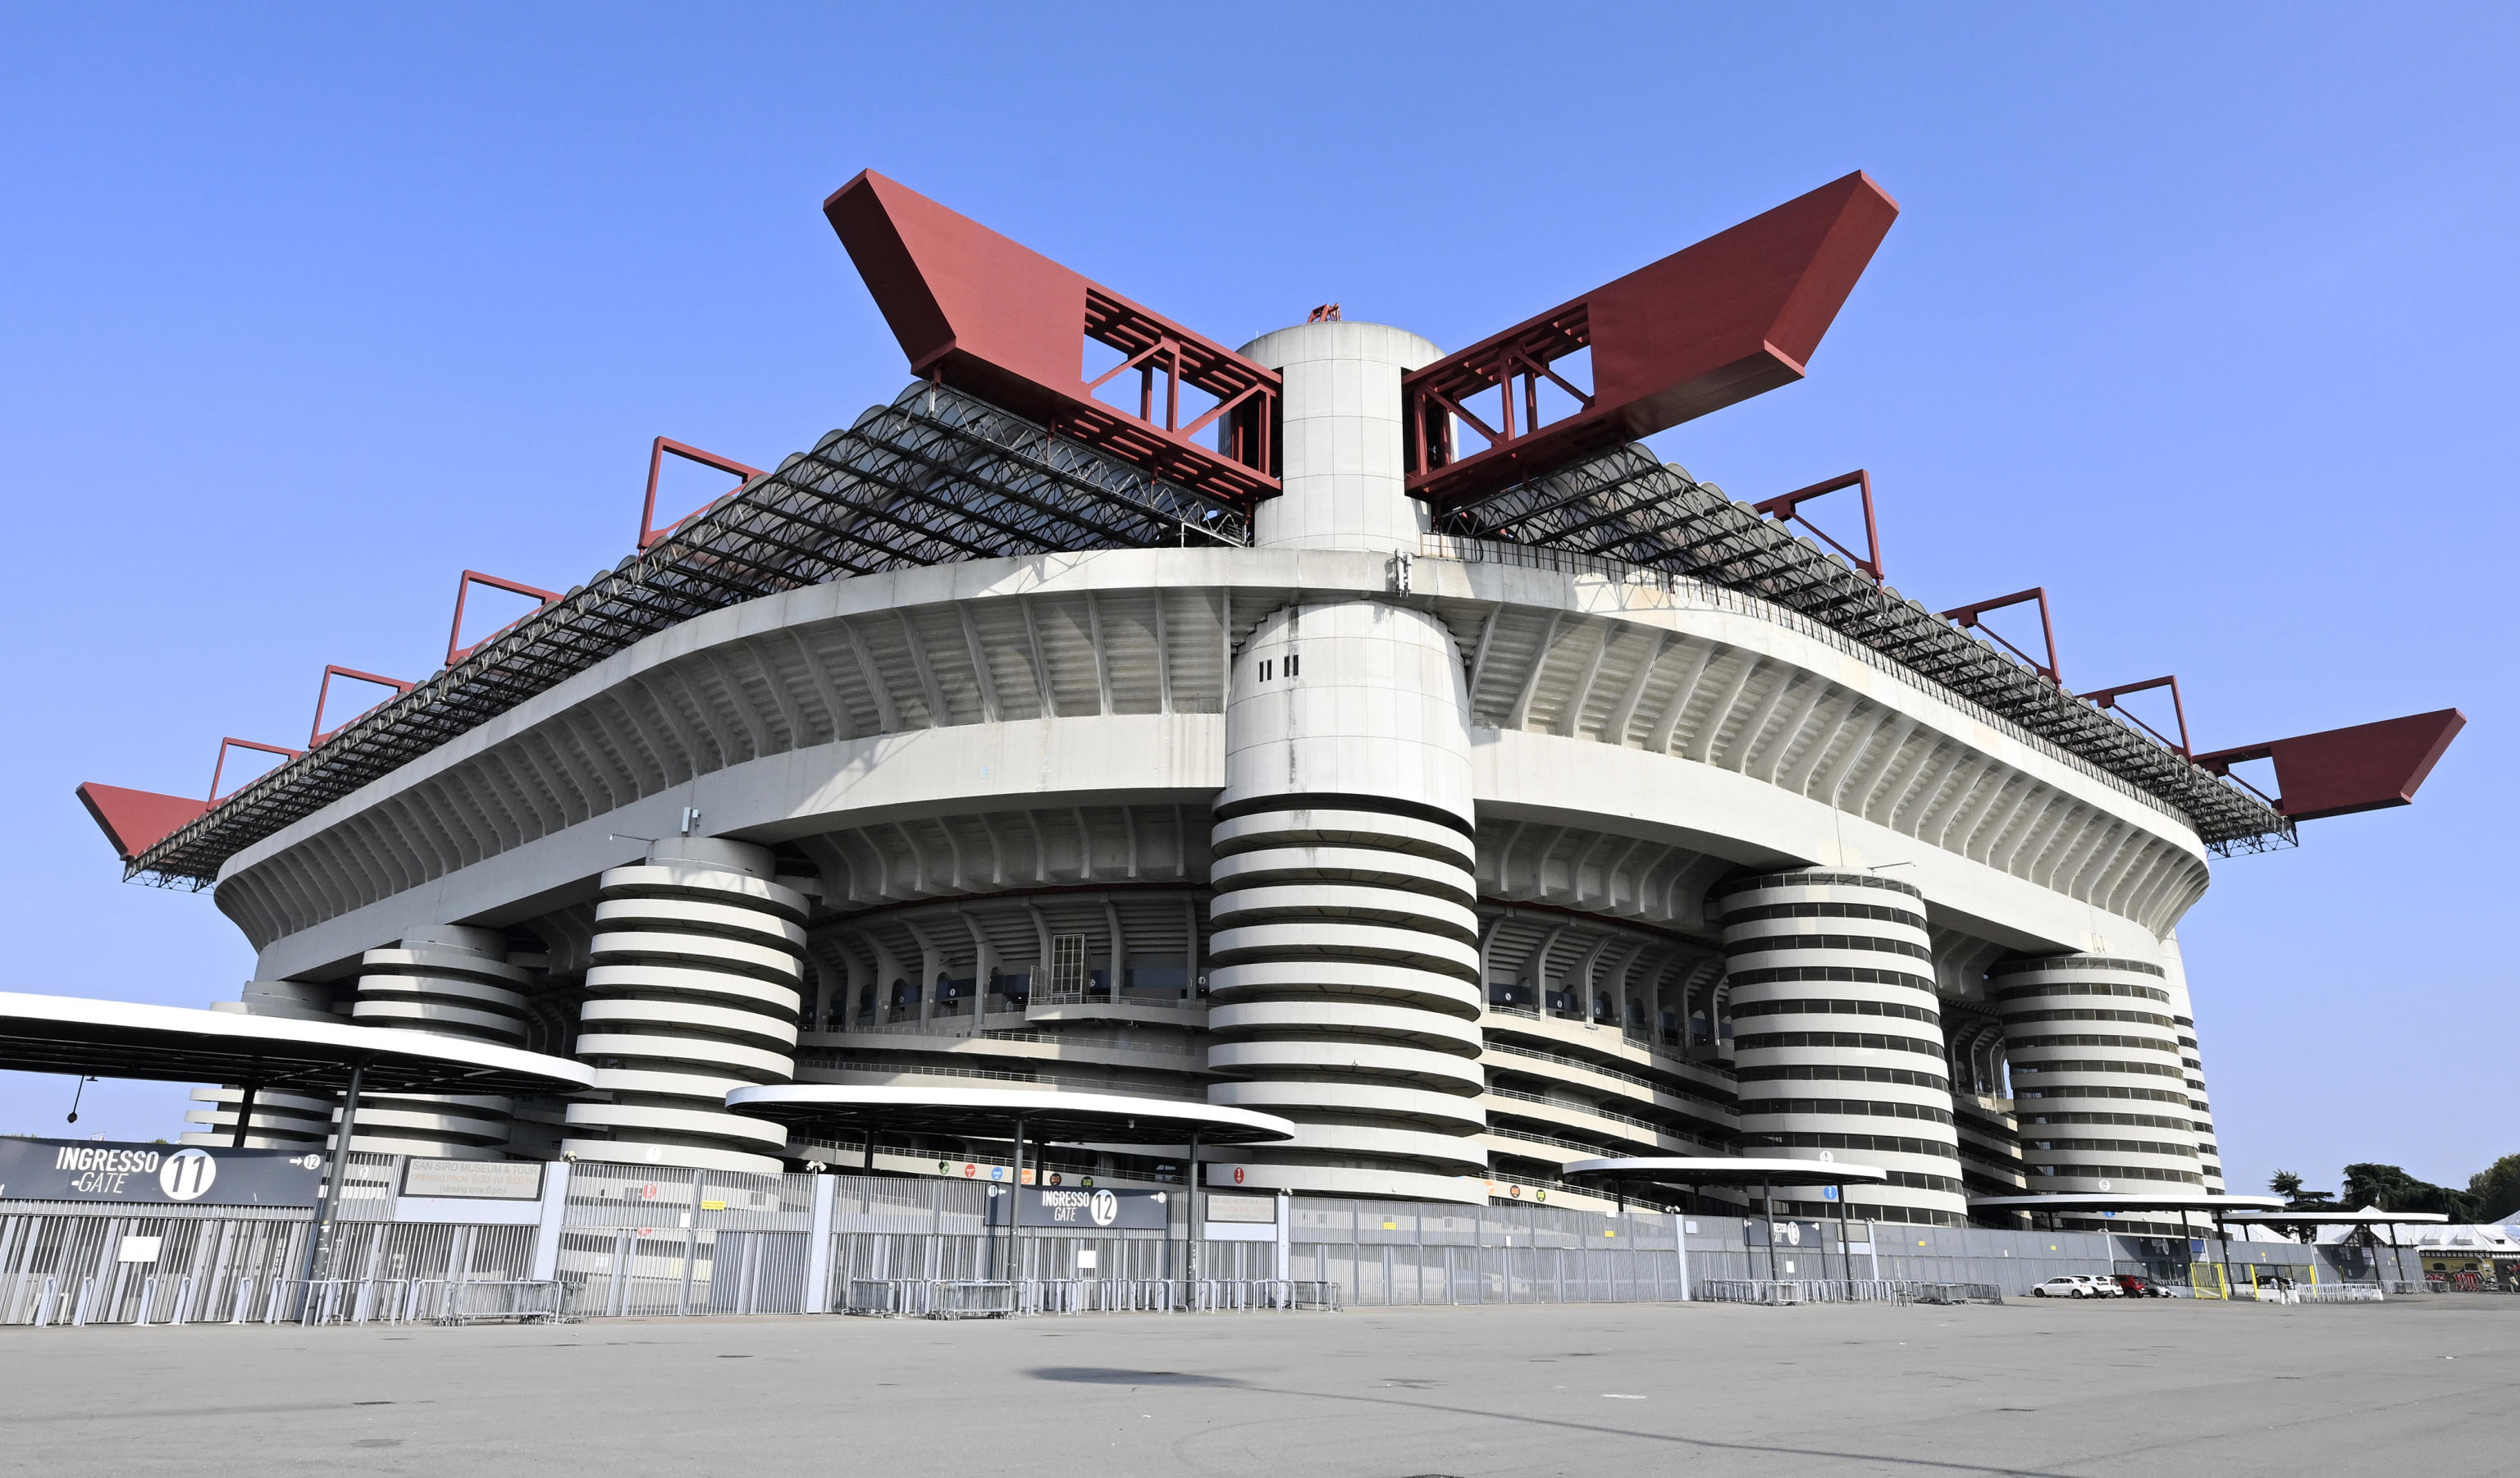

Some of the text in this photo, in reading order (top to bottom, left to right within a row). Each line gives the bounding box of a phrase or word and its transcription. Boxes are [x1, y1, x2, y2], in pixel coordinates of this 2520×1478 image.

[56, 1147, 159, 1173] INGRESSO
[307, 1156, 318, 1168] 12
[413, 1161, 537, 1175] SAN SIRO MUSEUM & TOUR
[78, 1172, 130, 1193] GATE
[172, 1155, 206, 1193] 11
[440, 1184, 468, 1194] (closing
[469, 1185, 485, 1193] time
[492, 1187, 507, 1196] pm)
[1042, 1190, 1089, 1207] INGRESSO
[1054, 1207, 1077, 1221] GATE
[1095, 1193, 1112, 1220] 12
